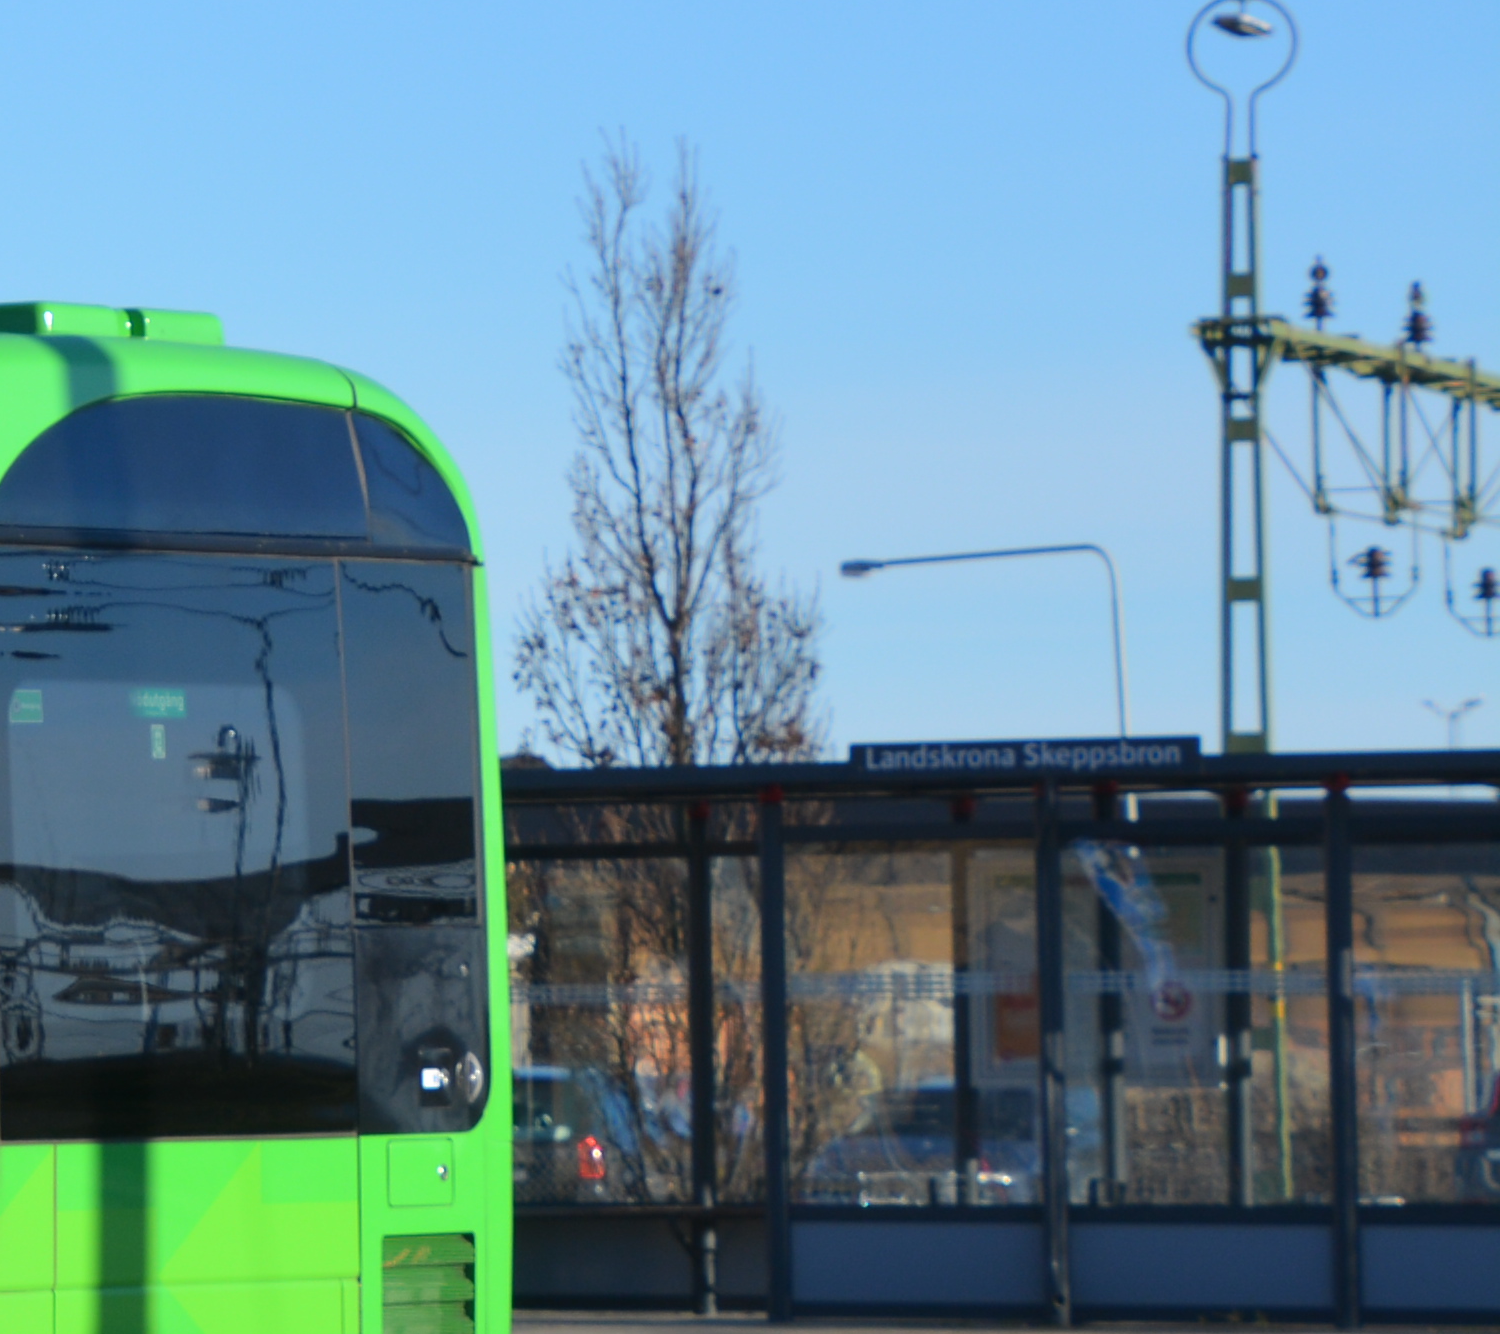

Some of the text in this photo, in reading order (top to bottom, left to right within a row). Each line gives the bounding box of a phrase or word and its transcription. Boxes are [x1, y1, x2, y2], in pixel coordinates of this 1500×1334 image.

[131, 691, 185, 711] ödutgång
[866, 740, 1182, 773] Landskrona Skeppsbron
